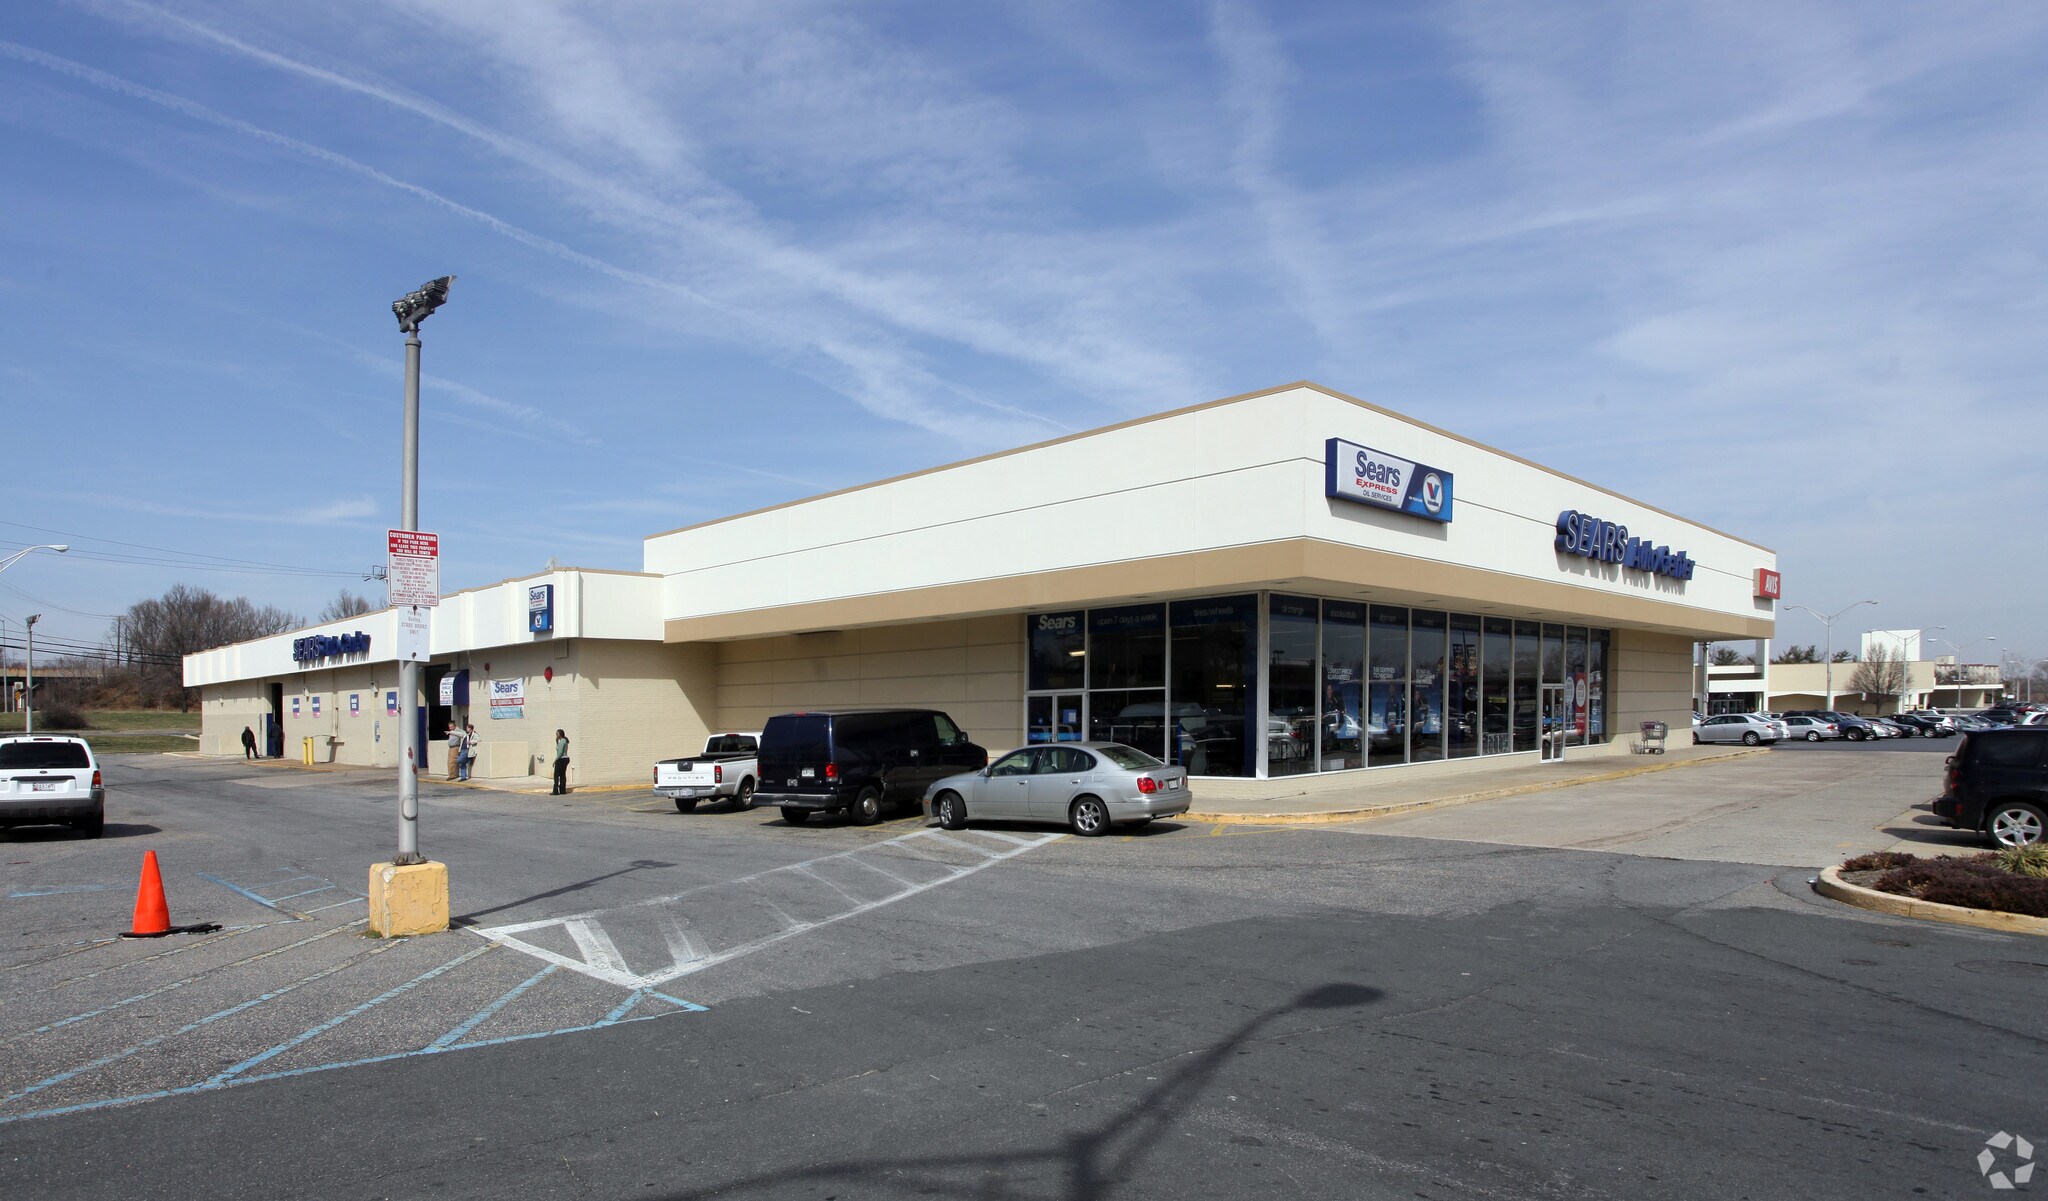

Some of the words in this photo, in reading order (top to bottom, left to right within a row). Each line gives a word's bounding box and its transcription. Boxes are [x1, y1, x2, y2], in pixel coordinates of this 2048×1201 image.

[1355, 450, 1401, 487] Sears
[1355, 478, 1398, 495] EXPRESS
[1362, 489, 1371, 497] OIL
[1371, 491, 1393, 502] SERVICES
[1555, 510, 1628, 565] SEARS
[1624, 536, 1657, 573] Auto
[1655, 545, 1695, 580] Center
[1764, 574, 1778, 594] AVIS
[1038, 614, 1076, 631] Sears
[293, 634, 322, 662] SEARS
[495, 681, 518, 693] Sears
